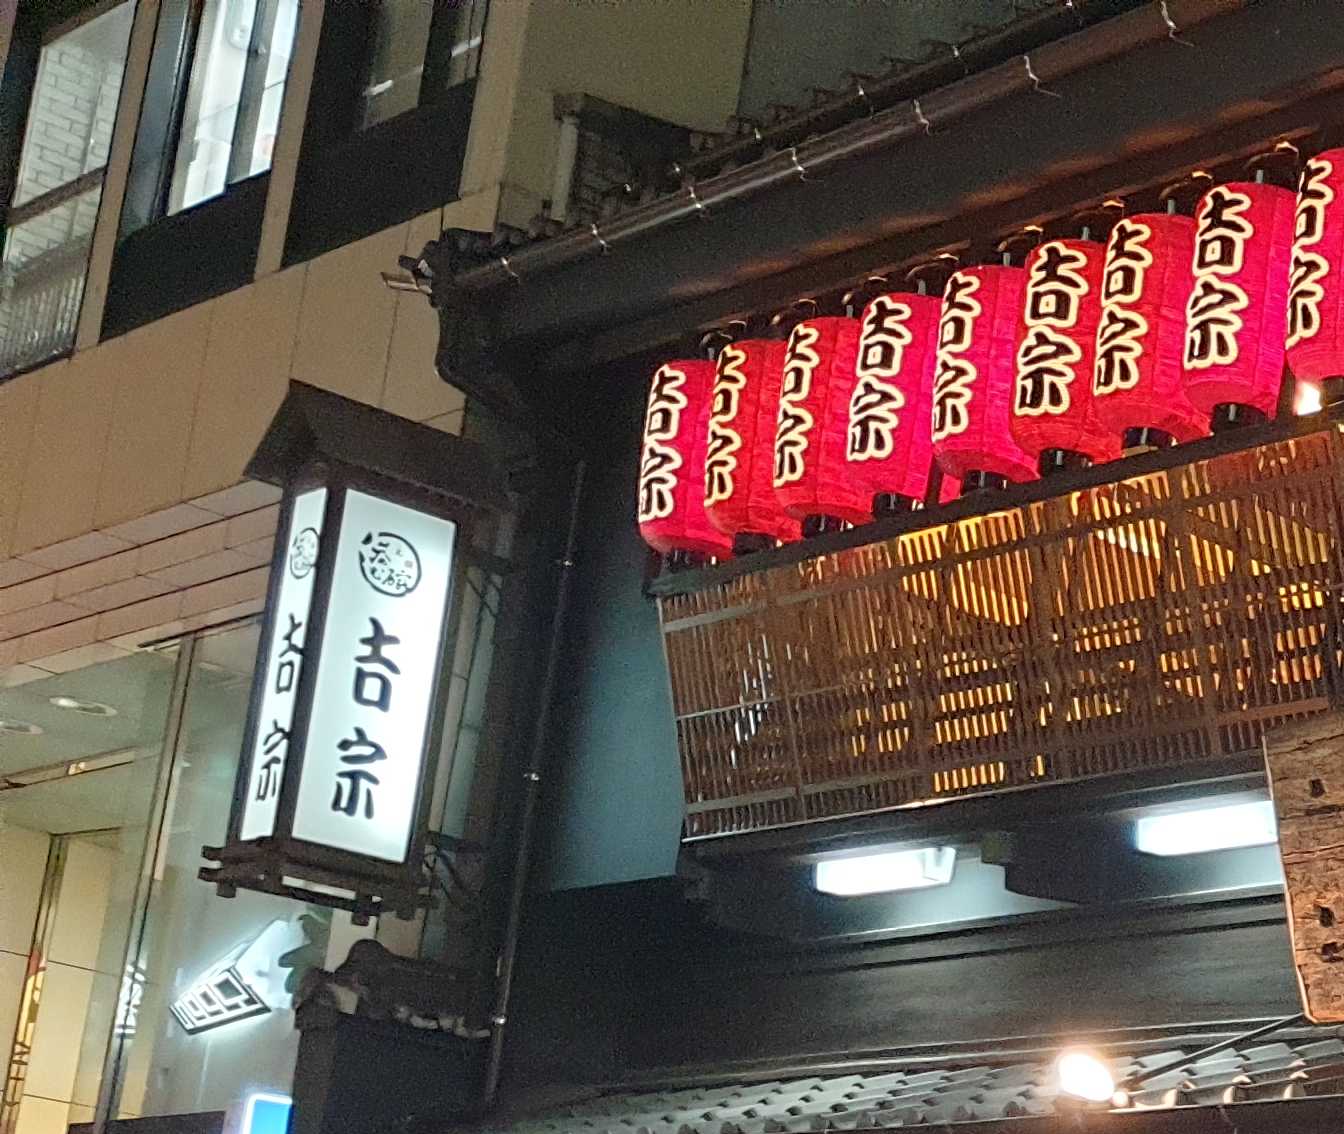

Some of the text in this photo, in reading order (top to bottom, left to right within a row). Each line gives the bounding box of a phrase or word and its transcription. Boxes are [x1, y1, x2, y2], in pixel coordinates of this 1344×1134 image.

[932, 271, 981, 442] 吉宗
[1015, 241, 1089, 416] 吉宗
[1094, 217, 1152, 396] 吉宗
[1184, 185, 1253, 371] 吉宗
[638, 364, 687, 523] 吉宗
[704, 344, 746, 507] 吉宗
[773, 323, 820, 487] 吉宗
[847, 296, 912, 462] 吉宗
[254, 612, 305, 802] 吉宗
[331, 616, 401, 820] 吉宗
